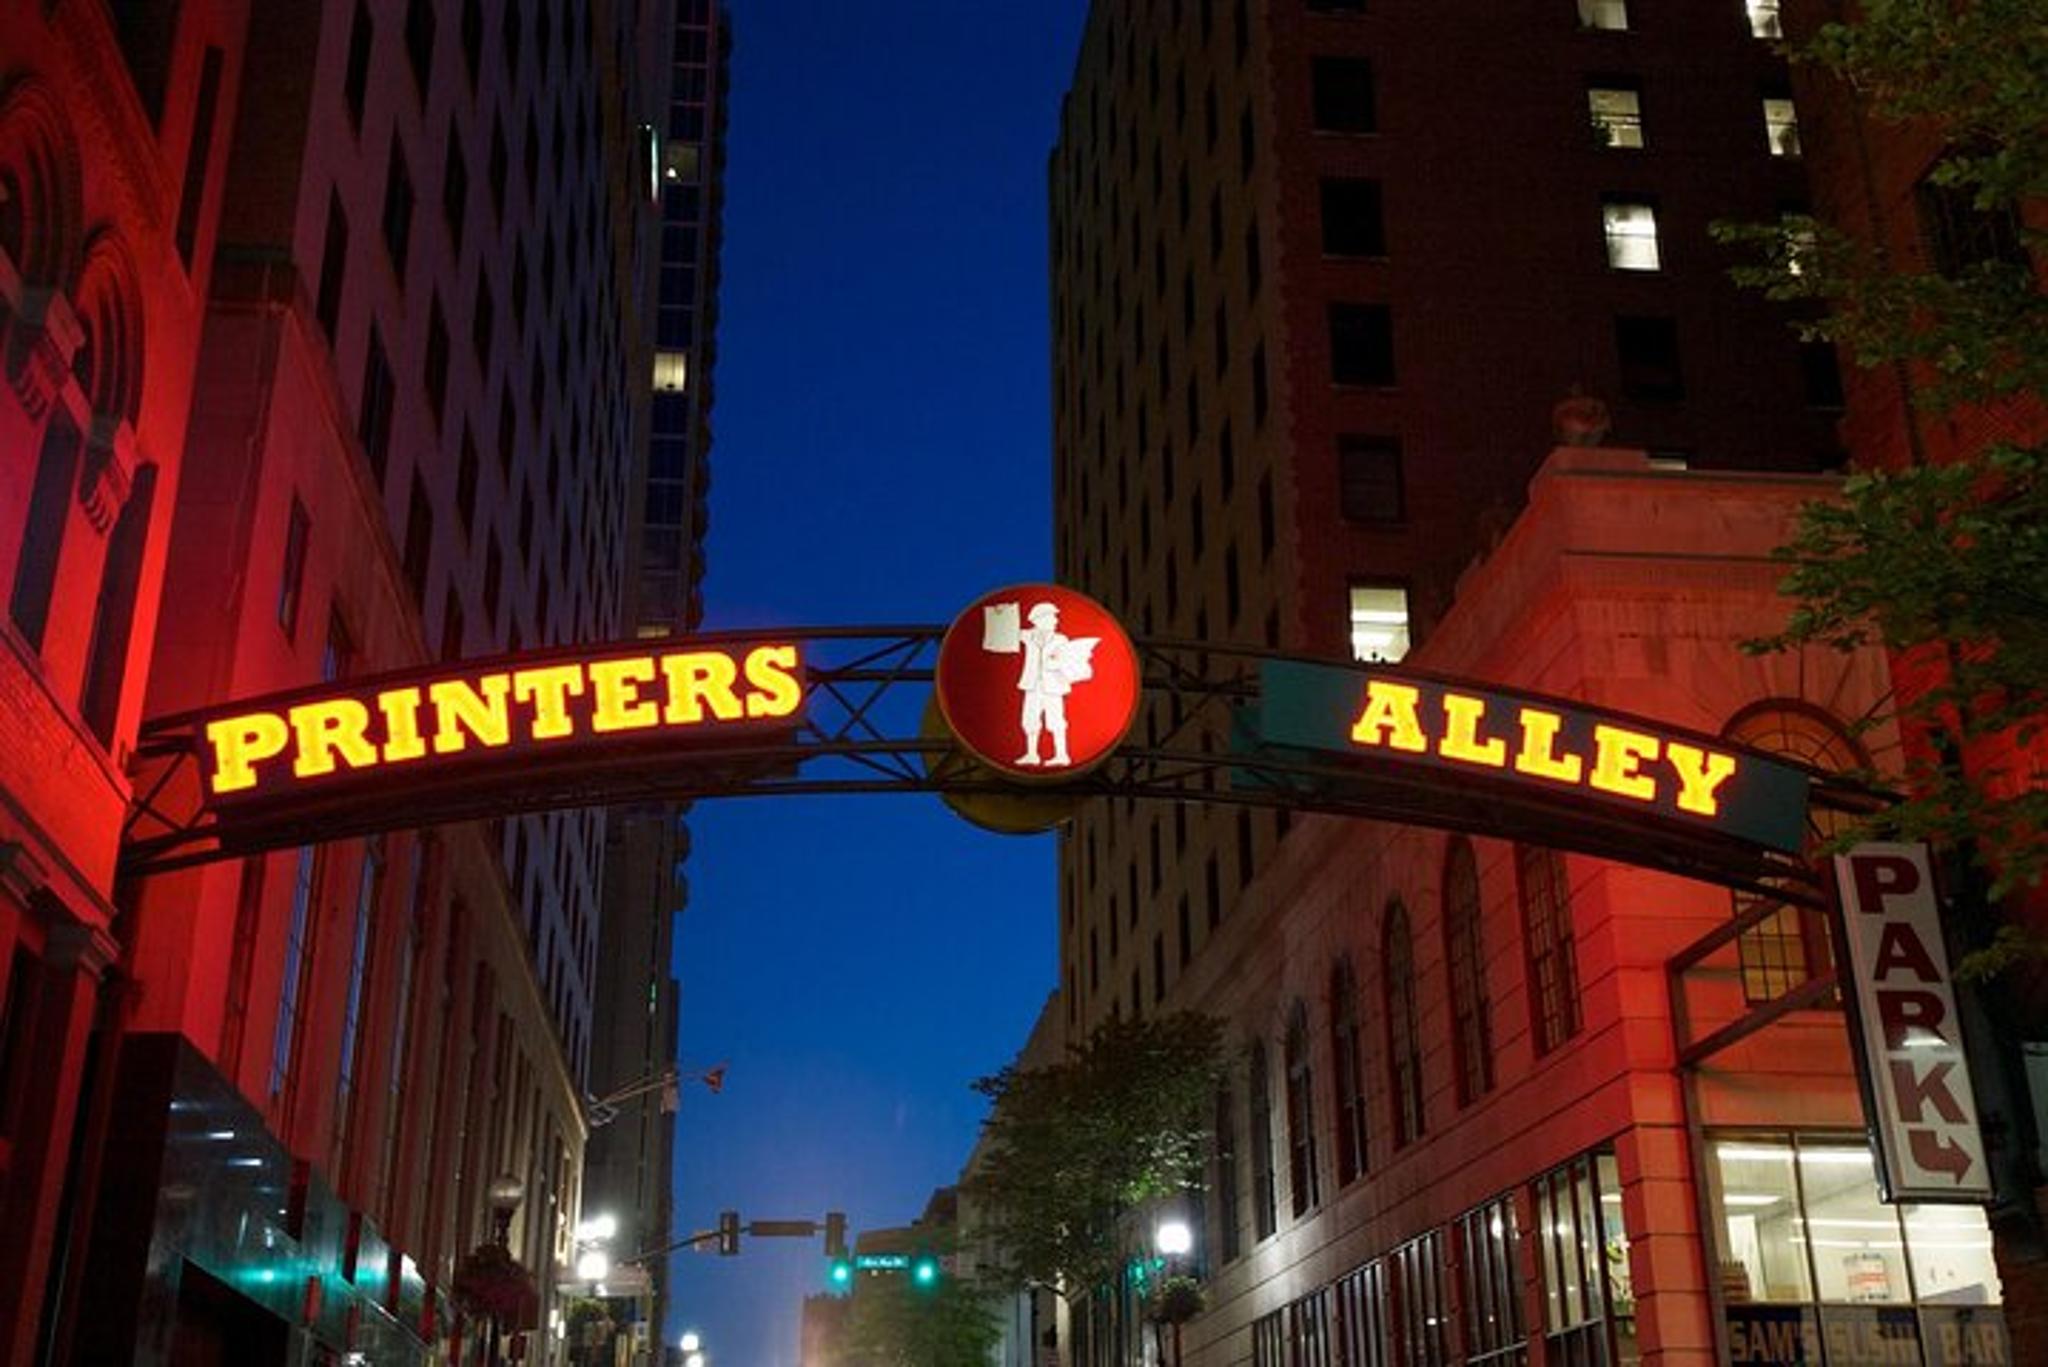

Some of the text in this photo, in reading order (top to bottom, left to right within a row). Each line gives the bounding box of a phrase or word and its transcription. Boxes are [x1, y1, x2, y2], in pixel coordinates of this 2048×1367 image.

[206, 645, 1736, 816] PRINTERS ALLEY
[1851, 856, 1969, 1124] PARK
[1728, 1320, 1820, 1363] SAM'S
[1939, 1322, 2005, 1364] BAR
